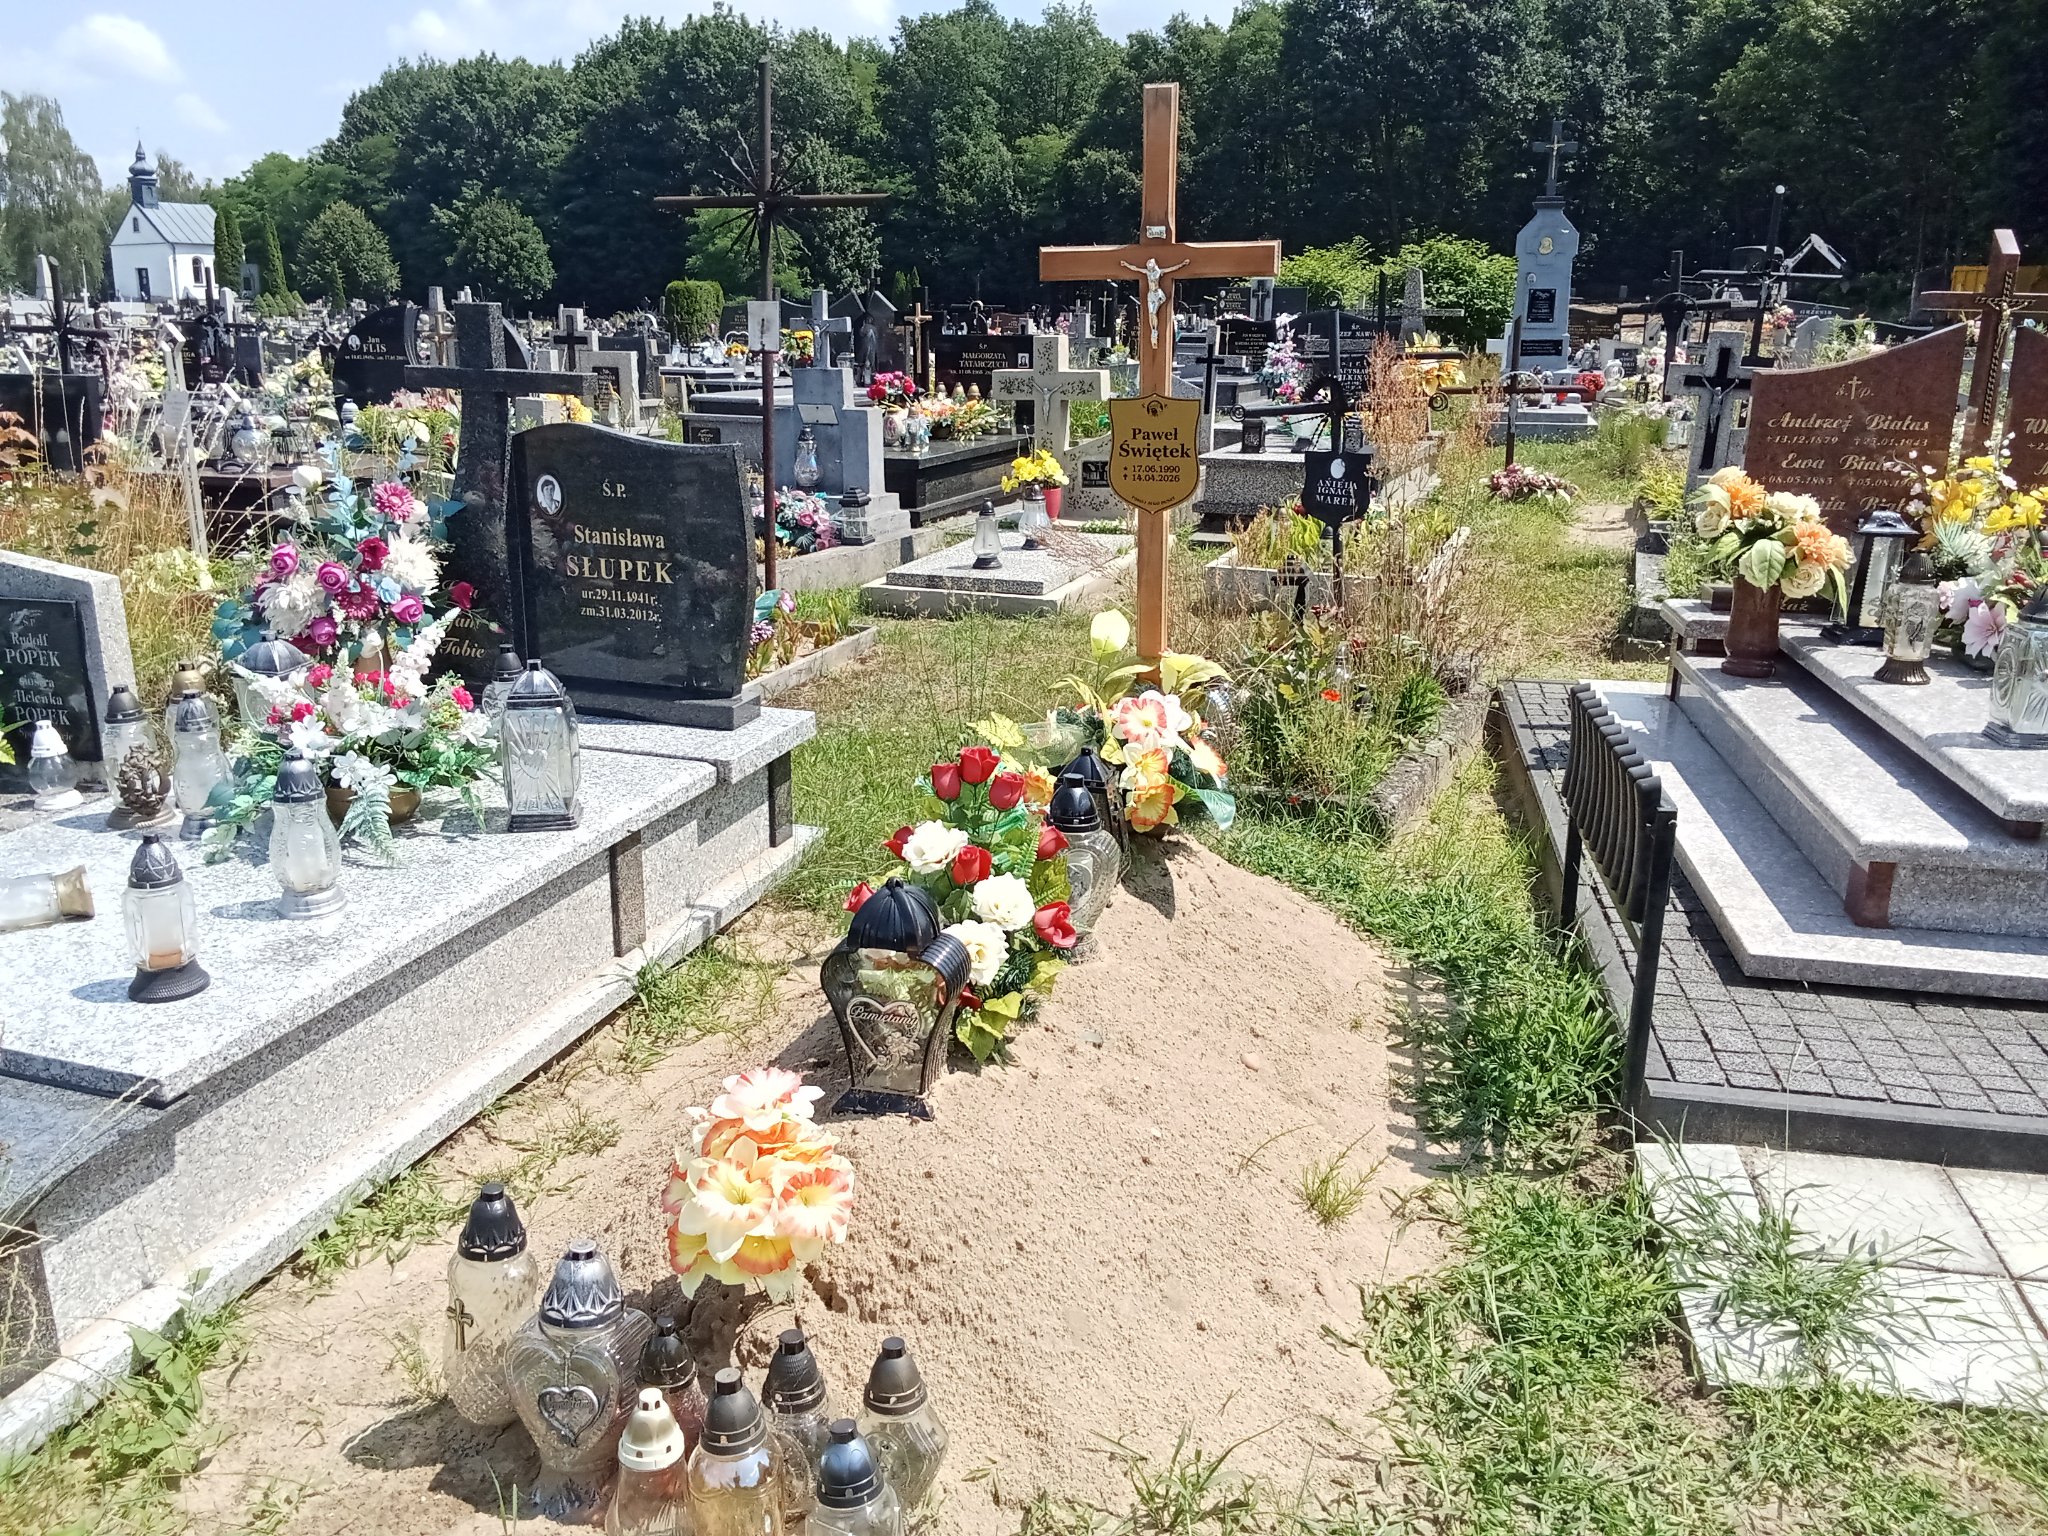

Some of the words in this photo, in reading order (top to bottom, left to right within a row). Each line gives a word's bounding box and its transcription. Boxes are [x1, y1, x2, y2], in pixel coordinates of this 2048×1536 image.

[362, 343, 387, 353] FLIS
[1767, 412, 1853, 433] Andrzej
[1131, 427, 1179, 441] Paweł
[1118, 439, 1191, 462] Świętek
[1131, 464, 1181, 474] 17.06.1990
[1781, 452, 1825, 470] Ewa
[602, 478, 627, 498] Ś.P.
[1131, 473, 1181, 484] 14.04.2026
[574, 524, 666, 549] Stanisława
[566, 555, 674, 585] SŁUPEK
[11, 631, 49, 647] Rudolf
[440, 637, 486, 659] Tobie
[4, 647, 61, 667] POPEK
[14, 689, 63, 706] Helenka
[15, 706, 71, 726] POPEK
